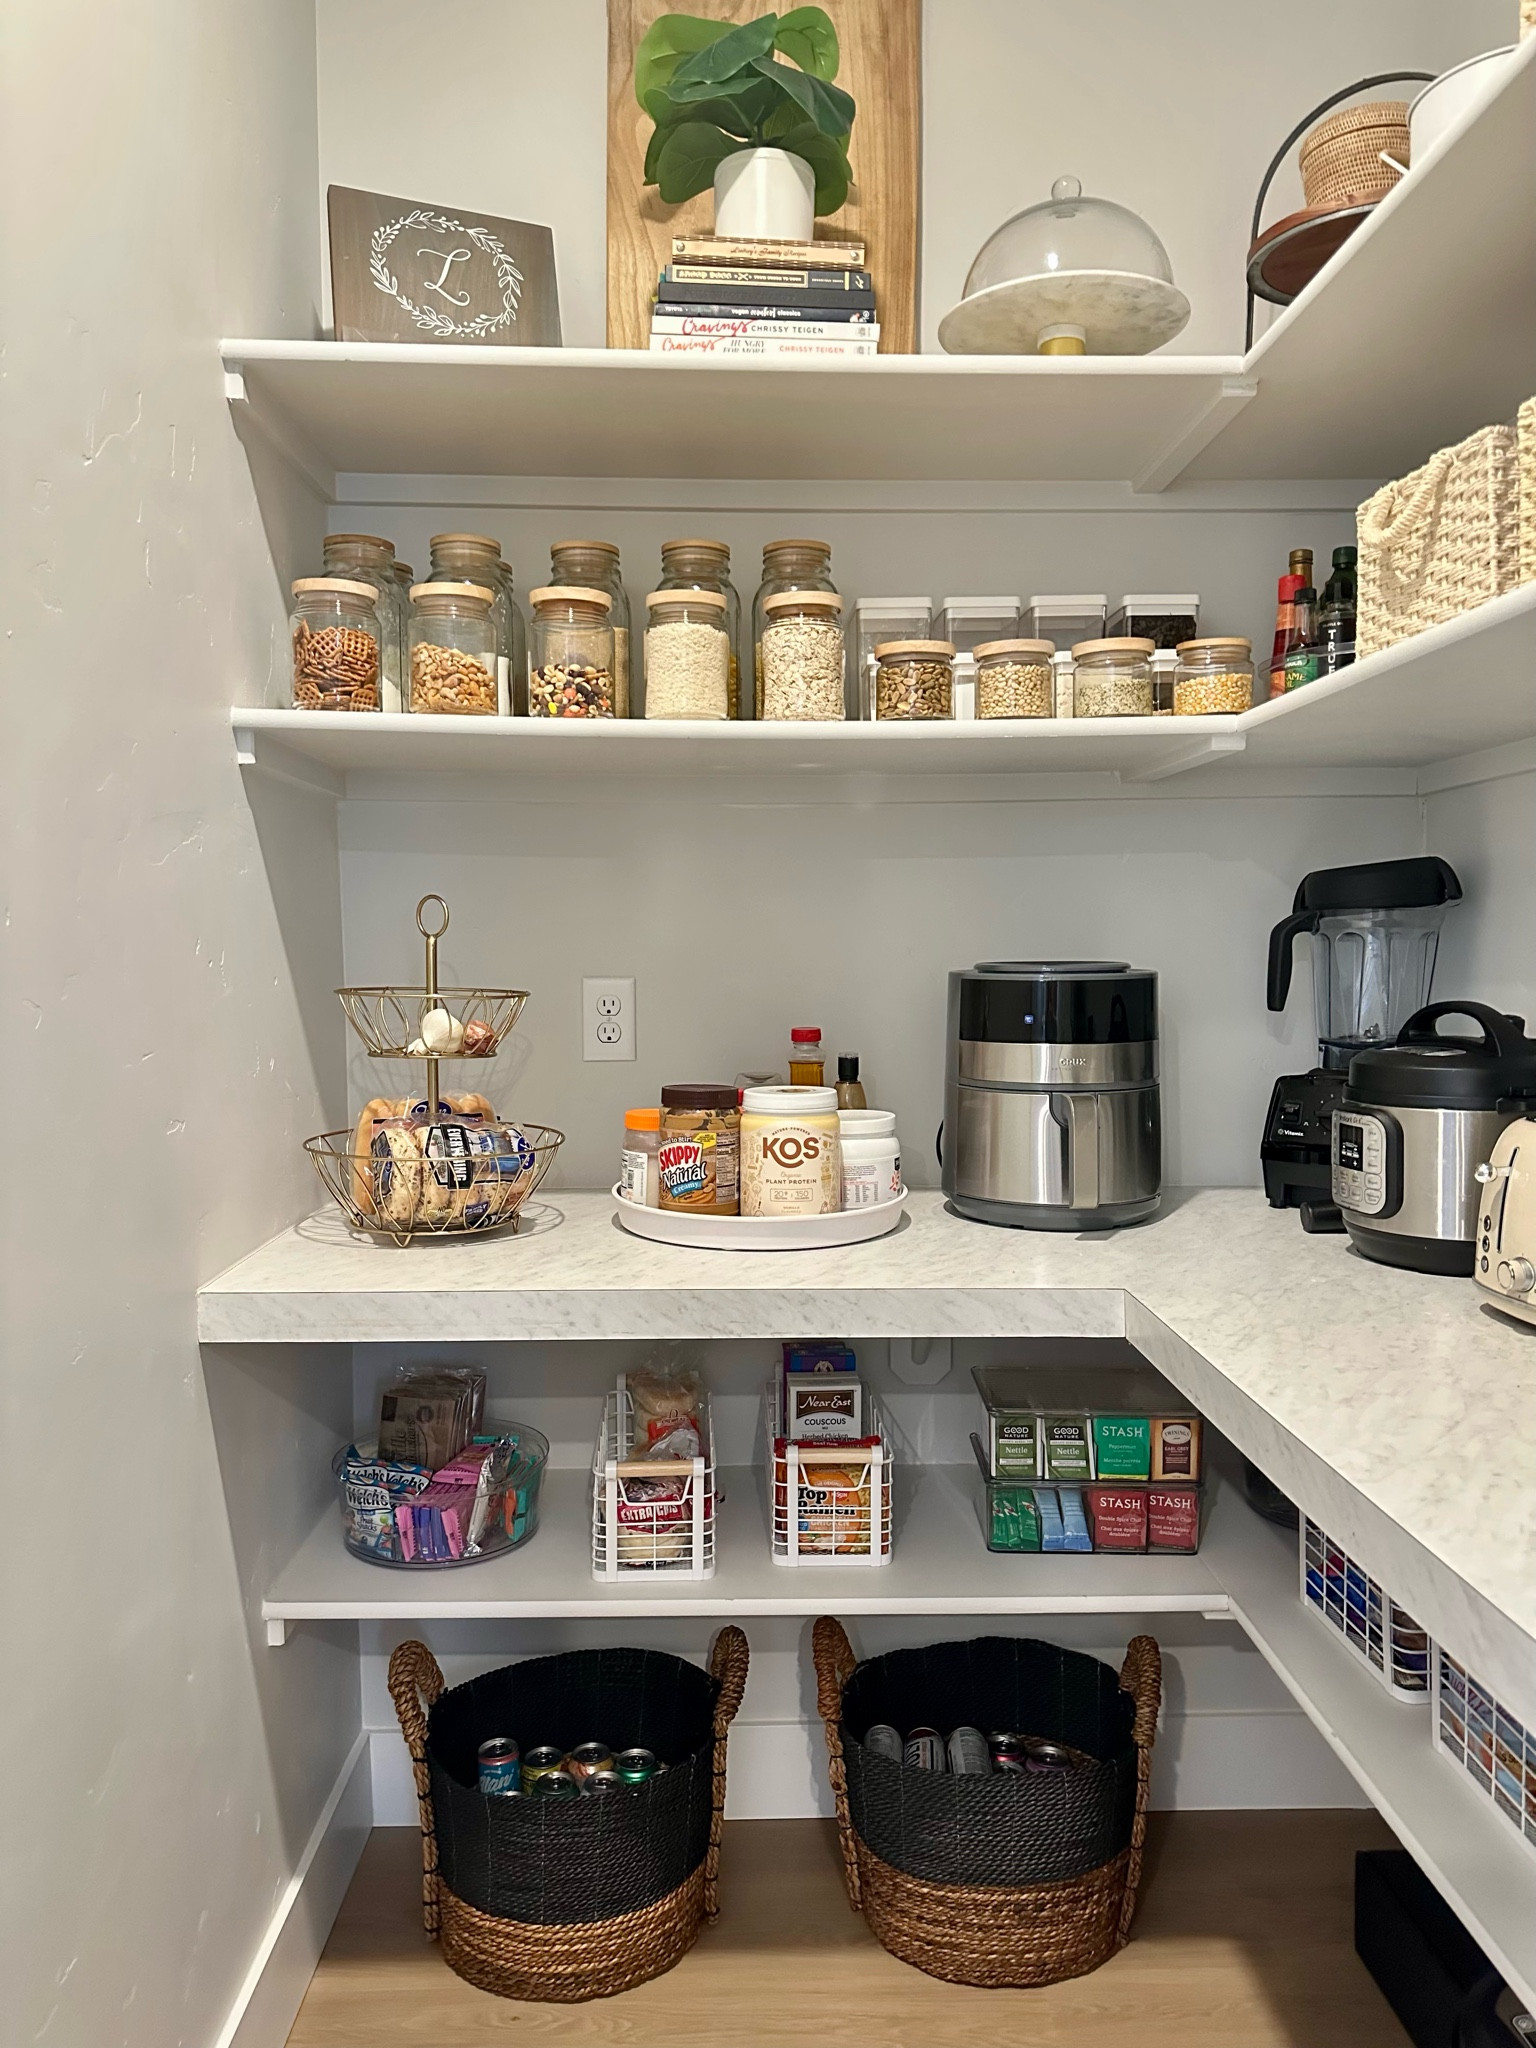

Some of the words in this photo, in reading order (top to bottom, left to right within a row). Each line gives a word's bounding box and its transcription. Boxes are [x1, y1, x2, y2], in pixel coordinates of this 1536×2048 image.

[417, 249, 471, 306] L
[682, 317, 755, 337] Cravings
[751, 325, 789, 333] CHRISSY
[662, 337, 720, 352] Cravings
[660, 1146, 700, 1172] SKIPPY
[762, 1137, 820, 1168] KOS
[663, 1161, 707, 1189] Natural
[674, 1181, 698, 1194] Creamy
[800, 1395, 831, 1409] Near
[831, 1395, 851, 1408] East
[804, 1418, 846, 1426] COUSCOUS
[1004, 1426, 1029, 1434] GOOD
[1053, 1427, 1079, 1435] GOOD
[1102, 1426, 1143, 1438] STASH
[798, 1487, 827, 1504] Top
[1150, 1495, 1190, 1509] STASH
[798, 1500, 857, 1515] Ramen
[1100, 1497, 1140, 1509] STASH
[621, 1507, 653, 1521] EXTRA
